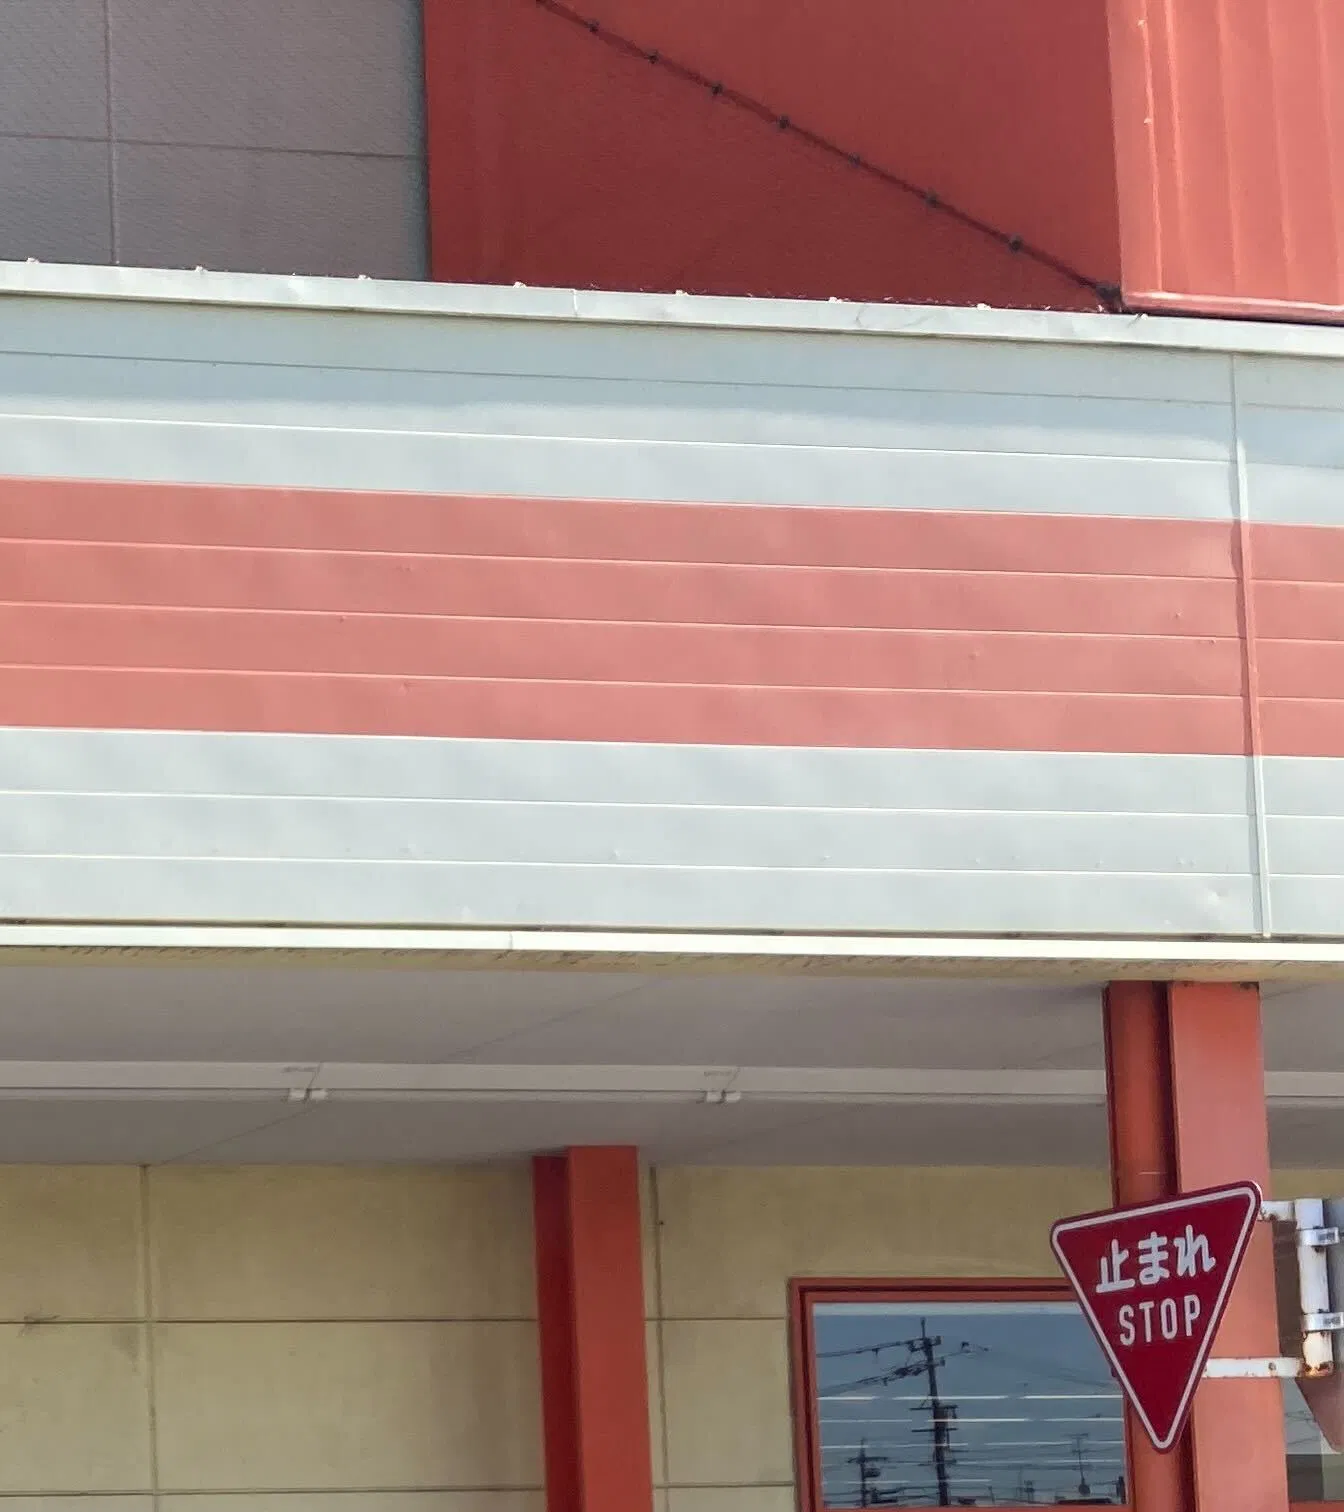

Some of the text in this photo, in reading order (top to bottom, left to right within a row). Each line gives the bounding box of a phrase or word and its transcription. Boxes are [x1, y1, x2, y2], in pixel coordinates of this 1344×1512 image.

[1096, 1224, 1216, 1293] 止まれ
[1119, 1294, 1201, 1346] STOP
